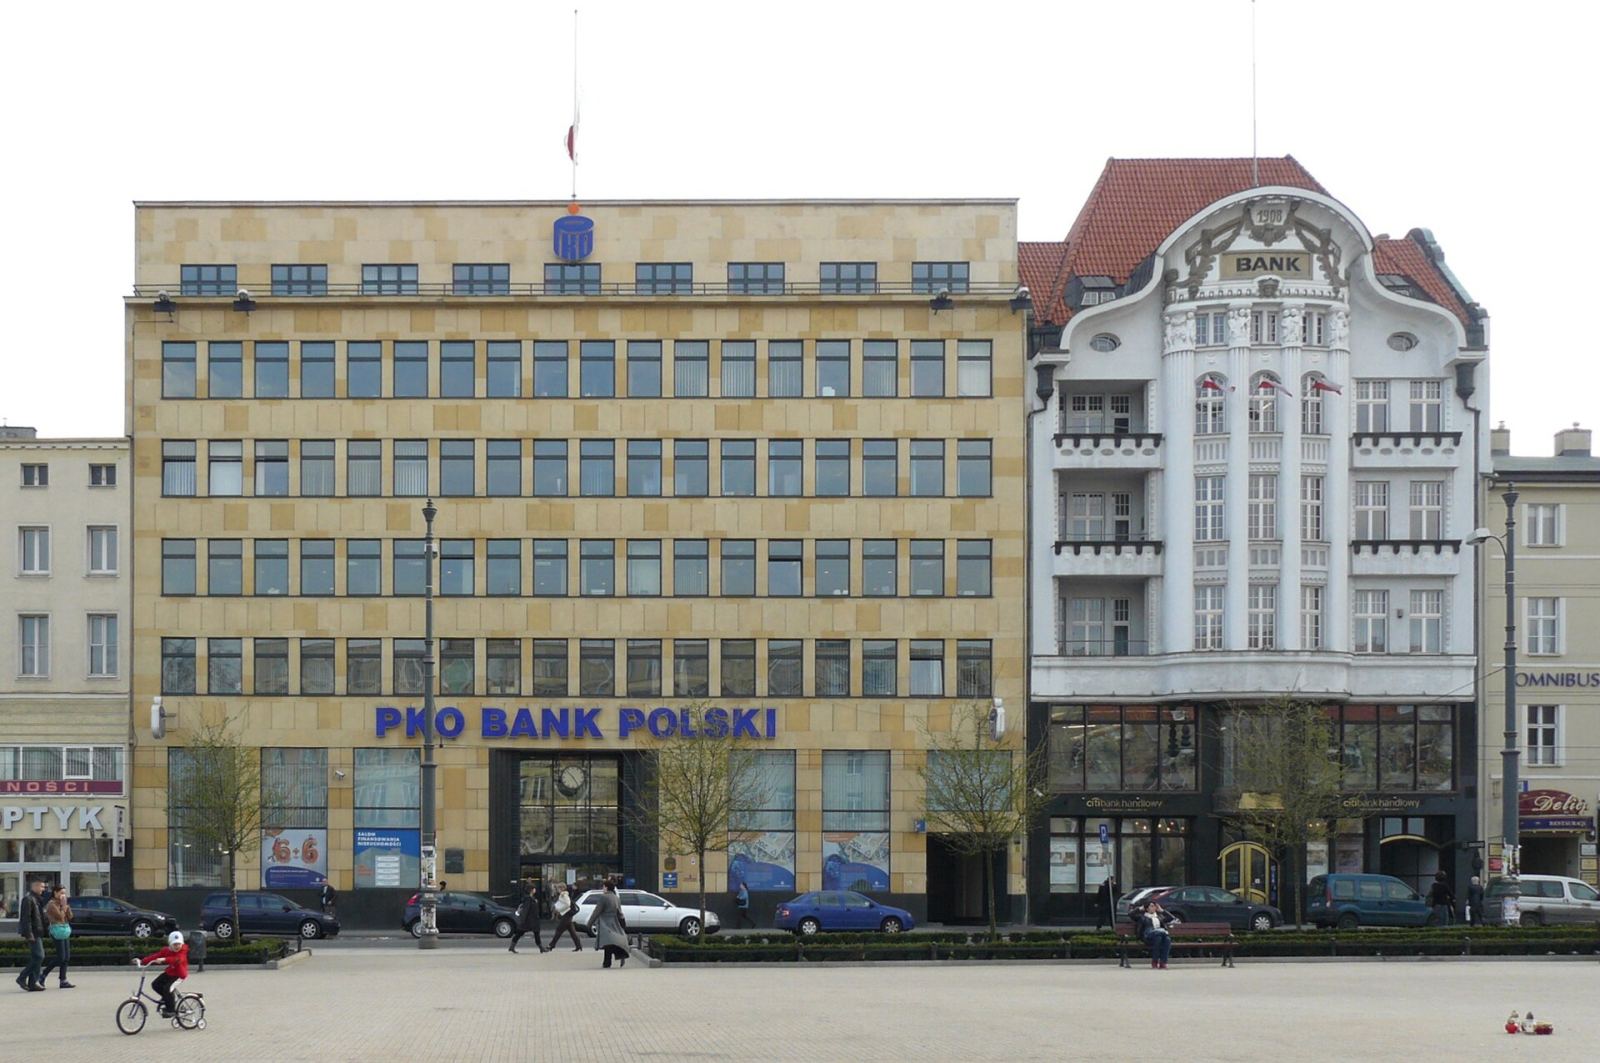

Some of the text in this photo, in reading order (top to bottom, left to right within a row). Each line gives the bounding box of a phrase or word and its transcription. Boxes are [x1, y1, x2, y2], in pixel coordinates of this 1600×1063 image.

[1256, 210, 1283, 223] 1908
[1236, 257, 1301, 272] BANK
[1514, 672, 1600, 687] OMNIBUS
[375, 706, 777, 739] PKO BANK POLSKI
[1086, 797, 1163, 808] citibank handlowy
[1378, 798, 1421, 809] handlowy
[0, 805, 104, 831] PTYK
